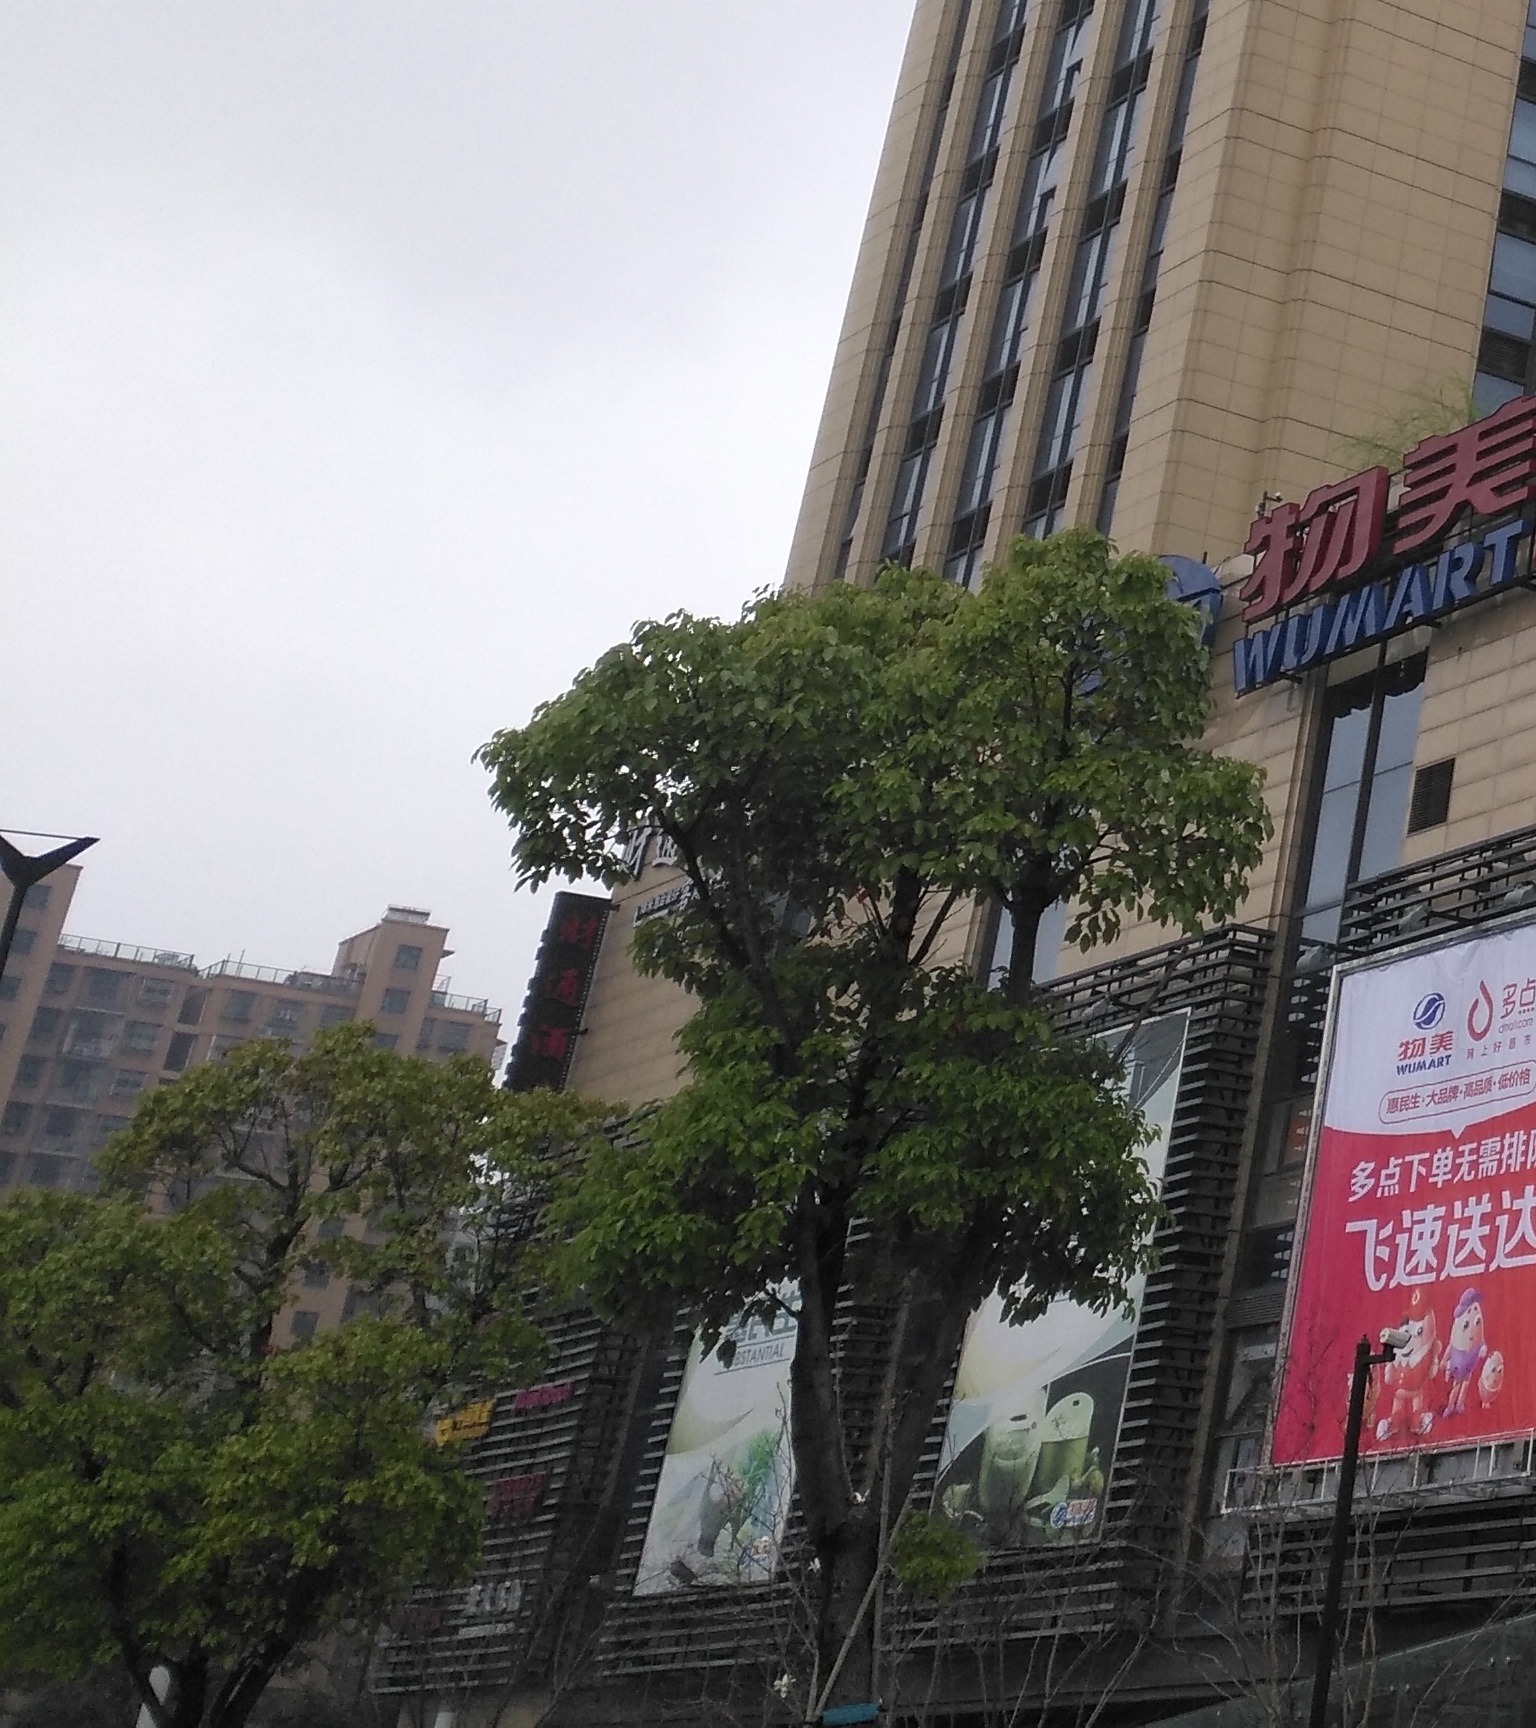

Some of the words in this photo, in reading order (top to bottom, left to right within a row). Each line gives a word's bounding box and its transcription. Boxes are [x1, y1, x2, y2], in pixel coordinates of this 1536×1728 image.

[1233, 518, 1532, 696] WUMART
[1500, 978, 1536, 1020] 多点
[1398, 1030, 1454, 1062] 物美
[1396, 1054, 1452, 1076] WUMART
[732, 1342, 785, 1367] BSTANTIAL
